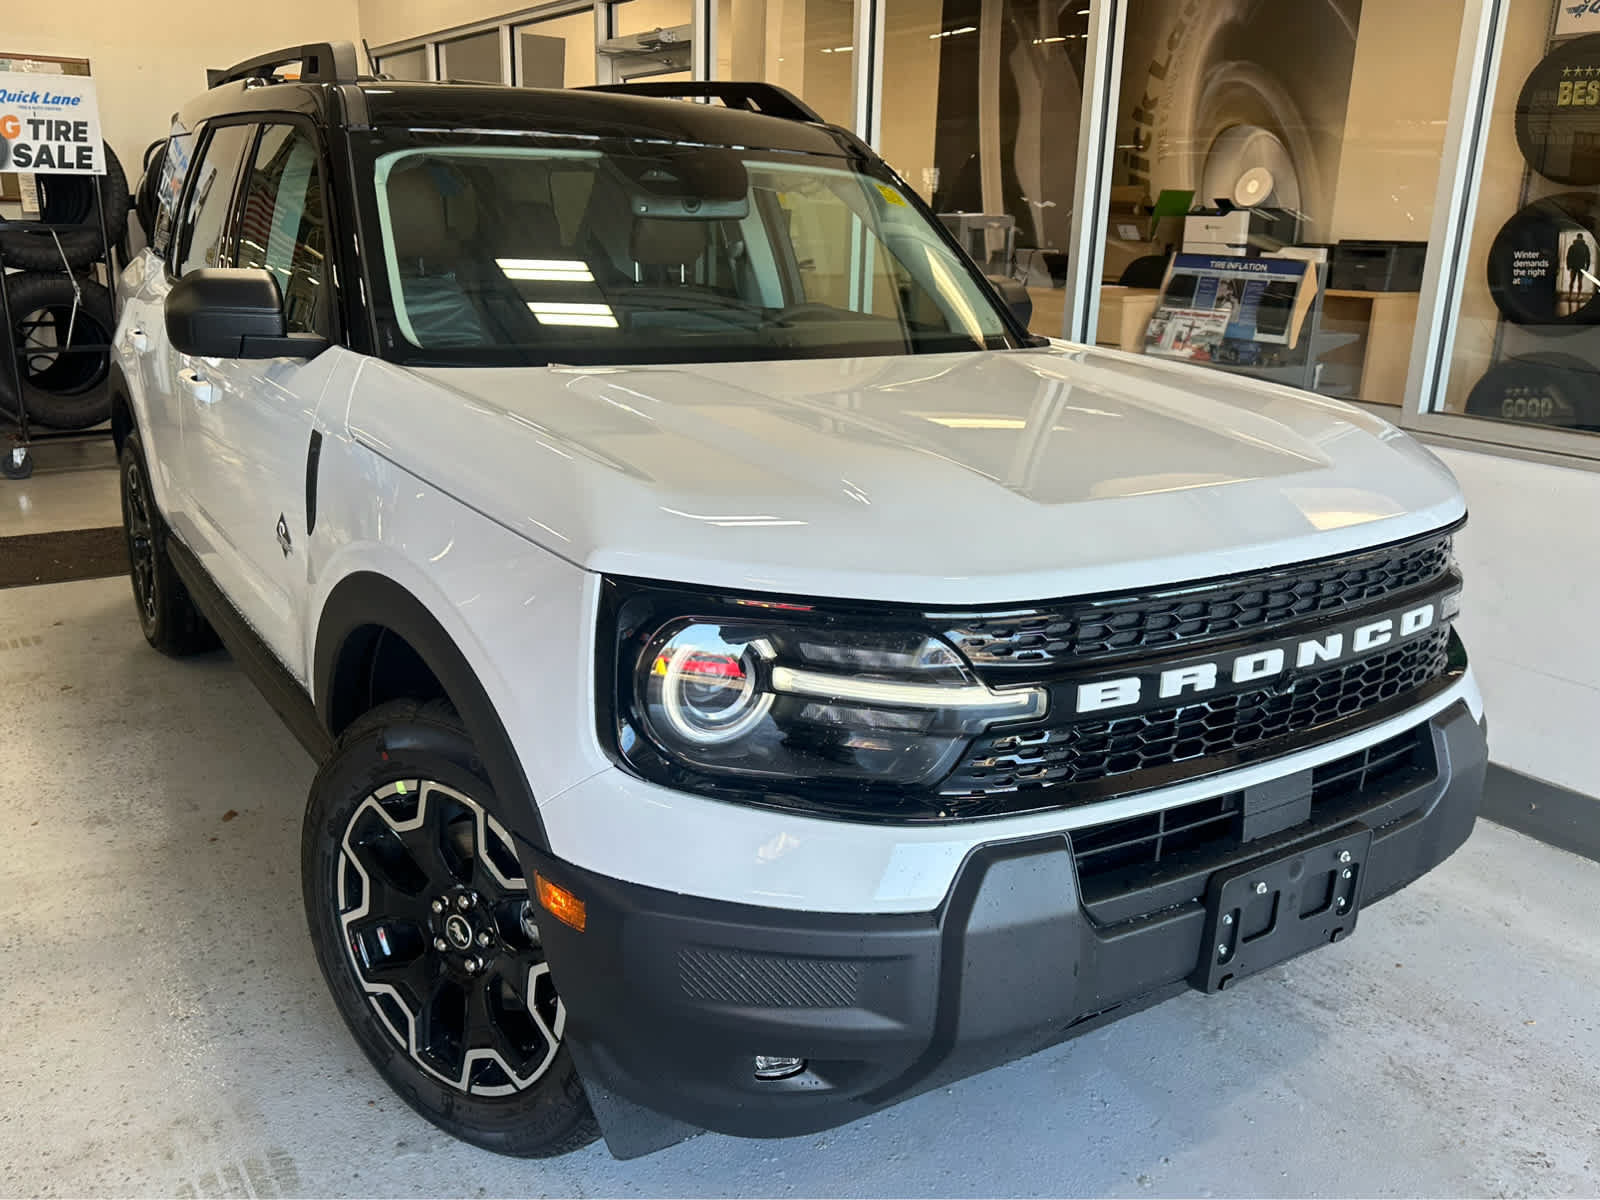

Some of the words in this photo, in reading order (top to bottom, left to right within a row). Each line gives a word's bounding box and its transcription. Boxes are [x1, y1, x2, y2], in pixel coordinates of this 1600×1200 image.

[0, 89, 38, 104] Quick
[42, 92, 81, 106] Lane
[1556, 80, 1600, 106] BES
[27, 119, 88, 142] TIRE
[13, 143, 93, 170] SALE
[1513, 250, 1540, 259] Winter
[1210, 260, 1226, 270] TIRE
[1226, 262, 1267, 272] INFLATION
[1513, 260, 1549, 268] demands
[1513, 268, 1526, 276] the
[1527, 268, 1546, 278] right
[1076, 604, 1434, 712] BRONCO
